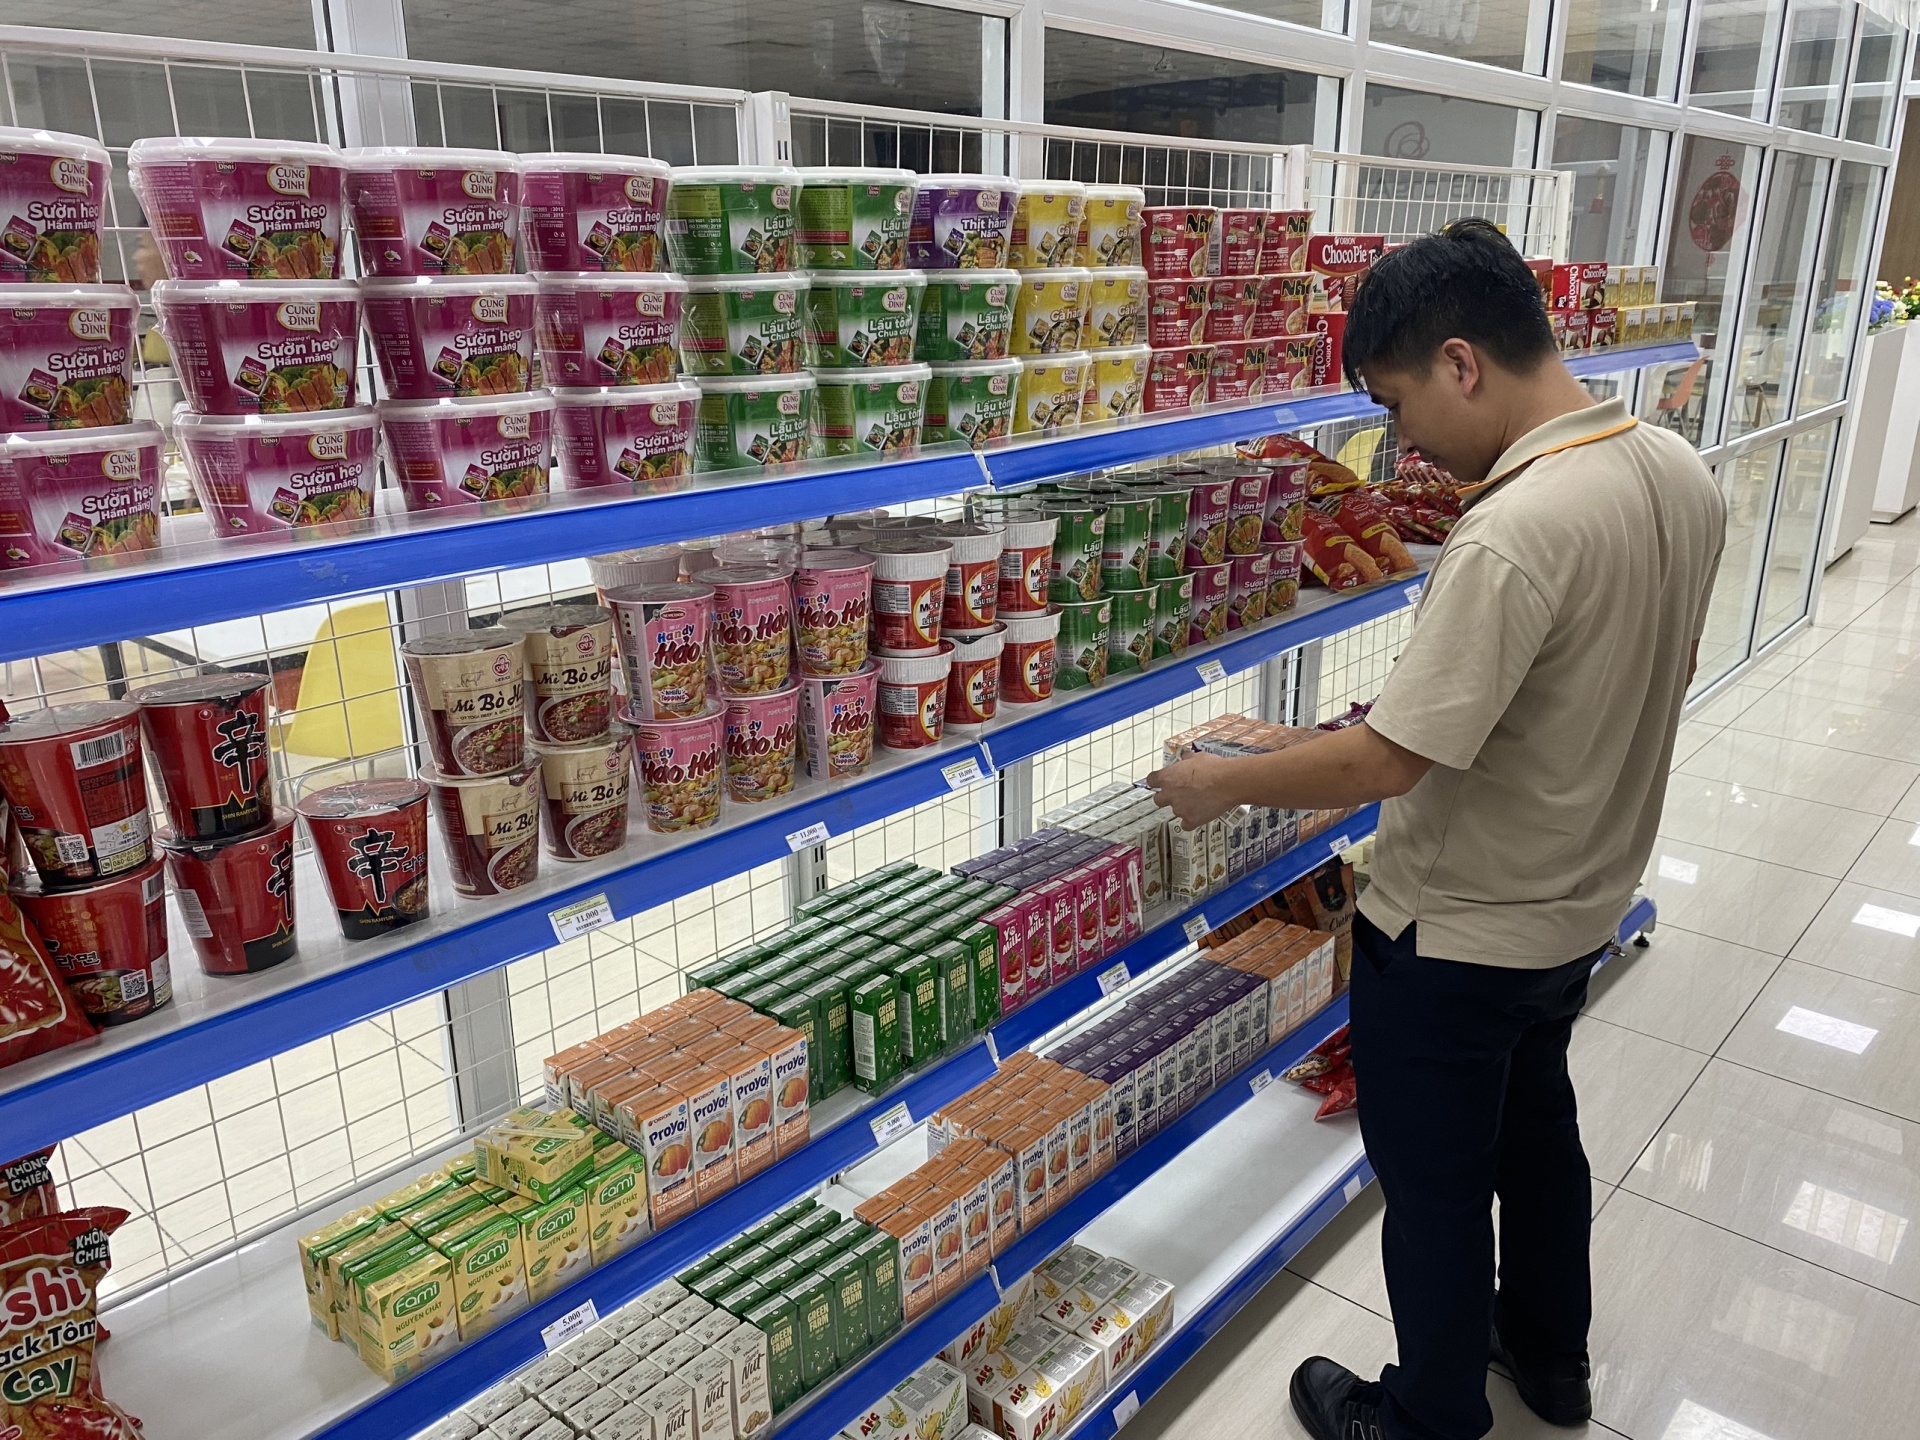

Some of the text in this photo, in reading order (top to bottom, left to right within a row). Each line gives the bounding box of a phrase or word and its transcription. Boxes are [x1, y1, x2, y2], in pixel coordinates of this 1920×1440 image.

[276, 167, 305, 180] CUNG
[469, 173, 493, 184] CUNG
[248, 205, 326, 222] Sườn heo
[443, 208, 508, 223] Sườn heo
[645, 210, 661, 222] heo
[1185, 214, 1213, 233] Nh
[265, 221, 292, 231] Hầm
[1322, 244, 1367, 264] ChocoPie
[286, 303, 314, 316] CUNG
[869, 318, 892, 333] Lẩu
[500, 329, 522, 344] heo
[258, 339, 337, 360] Sườn heo
[1315, 320, 1329, 385] ChocoPie
[49, 349, 125, 371] Sườn heo
[275, 356, 300, 367] Hầm
[315, 434, 344, 446] CUNG
[519, 443, 542, 457] heo
[290, 463, 362, 490] Sườn heo
[710, 608, 742, 622] Handy
[711, 605, 789, 644] Hảo Hảo
[657, 624, 694, 643] Handy
[654, 637, 700, 668] Hảo
[562, 666, 587, 685] Bò
[479, 691, 504, 711] Bò
[834, 697, 866, 714] Handy
[830, 707, 868, 735] Hảo
[212, 710, 266, 794] 辛
[590, 783, 614, 800] Bò
[347, 828, 409, 903] 辛
[576, 909, 599, 923] 11,000
[978, 944, 994, 961] GREEN
[979, 956, 994, 973] FARM
[916, 978, 934, 994] GREEN
[879, 998, 896, 1016] GREEN
[917, 990, 934, 1007] FARM
[879, 1011, 896, 1028] FARM
[4, 1154, 48, 1180] KHÔNG
[11, 1170, 49, 1194] CHIÊN
[600, 1174, 635, 1205] Fami
[537, 1207, 576, 1242] Fami
[75, 1227, 110, 1250] KHÔN
[75, 1242, 110, 1265] CHIÊ
[466, 1239, 510, 1274] Fami
[876, 1258, 895, 1278] GREEN
[877, 1268, 895, 1287] FARM
[393, 1280, 441, 1318] Fami
[1056, 1299, 1073, 1319] AFC
[395, 1300, 442, 1333] NGUYÊN CHẤT
[563, 1311, 580, 1326] 5,000
[807, 1305, 830, 1324] GREEN
[48, 1318, 96, 1346] Tôm
[770, 1325, 793, 1346] GREEN
[809, 1316, 830, 1335] FARM
[772, 1335, 793, 1355] FARM
[961, 1321, 985, 1360] AFC
[1111, 1334, 1134, 1371] AFC
[741, 1353, 765, 1385] Nut
[976, 1364, 994, 1386] AFC
[2, 1355, 78, 1404] Cay
[703, 1380, 729, 1413] Nut
[860, 1412, 881, 1437] AFC
